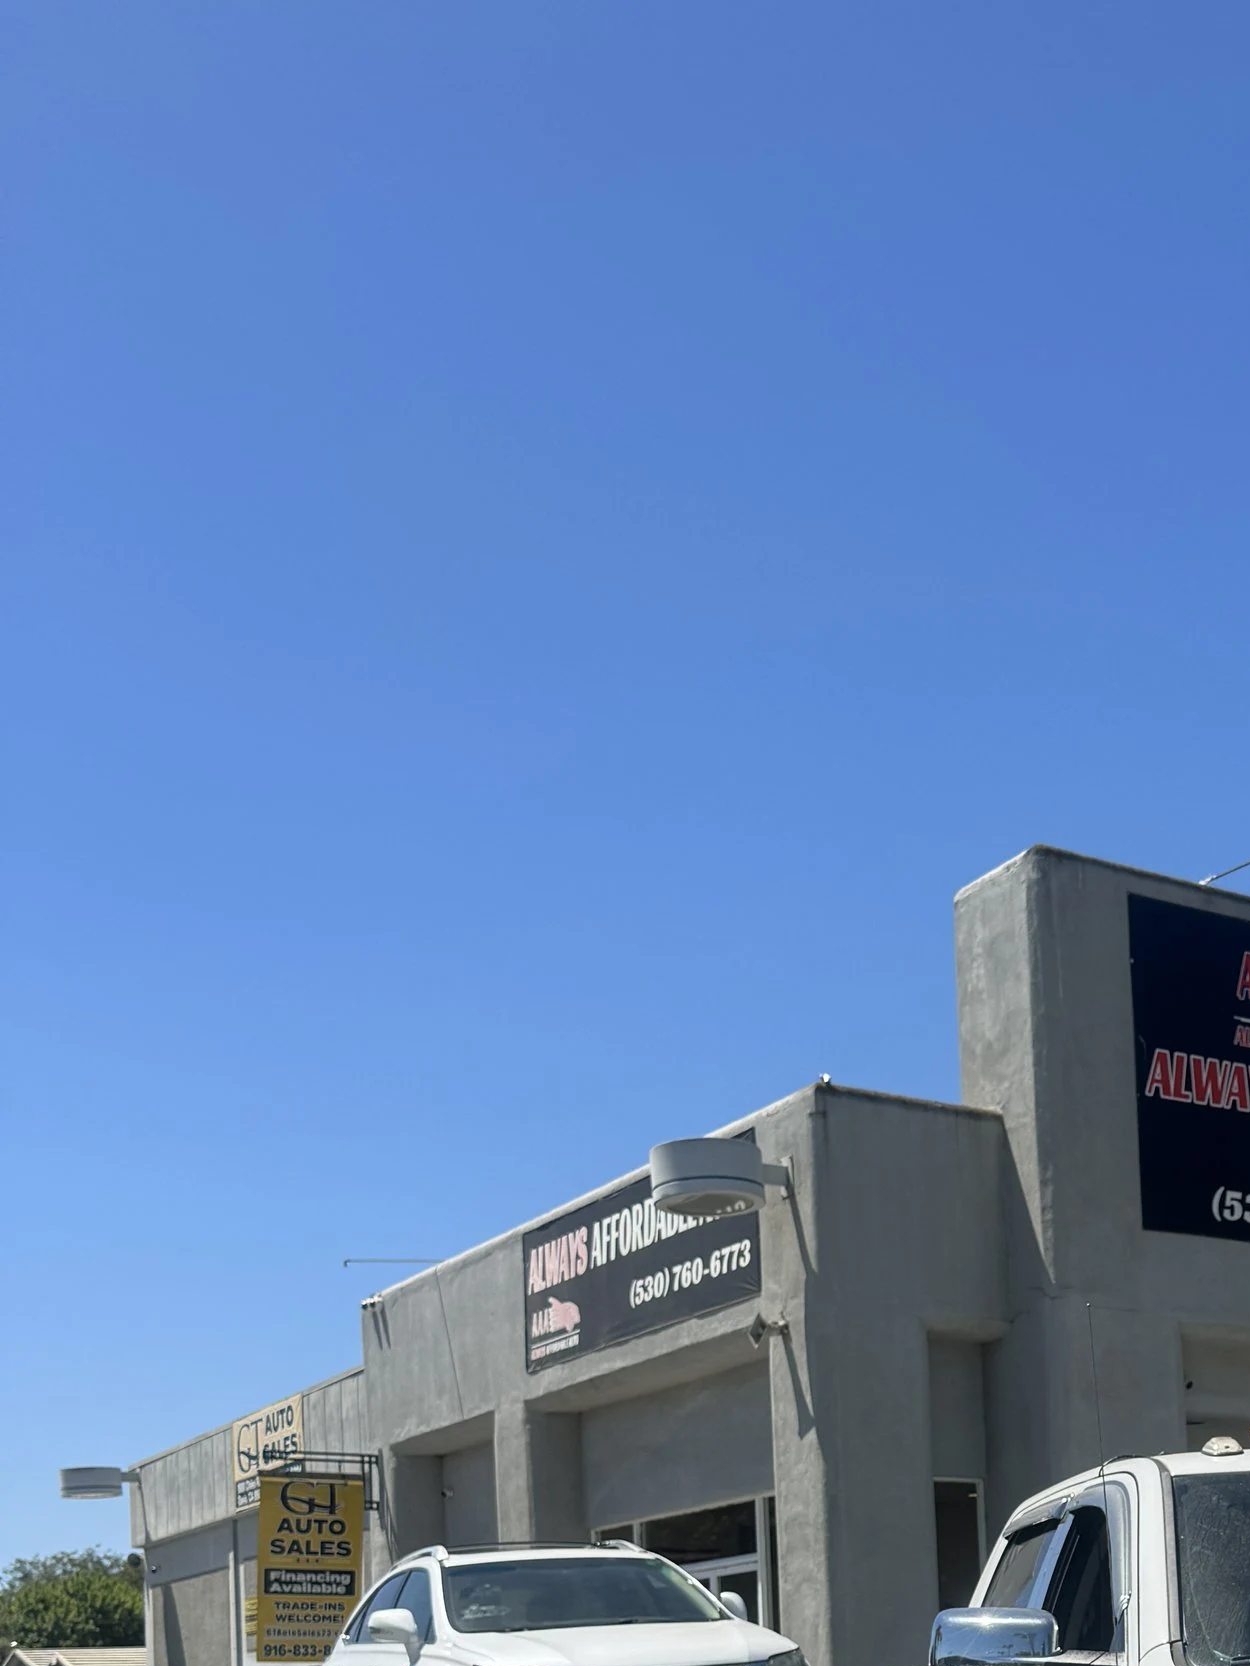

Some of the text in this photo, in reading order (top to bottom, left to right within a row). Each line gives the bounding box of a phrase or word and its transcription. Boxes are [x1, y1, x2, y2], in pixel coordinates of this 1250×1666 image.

[528, 1226, 588, 1296] ALWAYS
[629, 1239, 751, 1308] (530) 760-6773
[266, 1405, 294, 1435] AUTO
[263, 1433, 298, 1464] SALES
[281, 1480, 347, 1516] GT
[277, 1518, 346, 1535] AUTO
[270, 1538, 352, 1557] SALES
[269, 1570, 351, 1586] Financing
[269, 1581, 346, 1594] Available
[274, 1602, 345, 1612] TRADE-INS
[263, 1644, 332, 1657] 916-833-8
